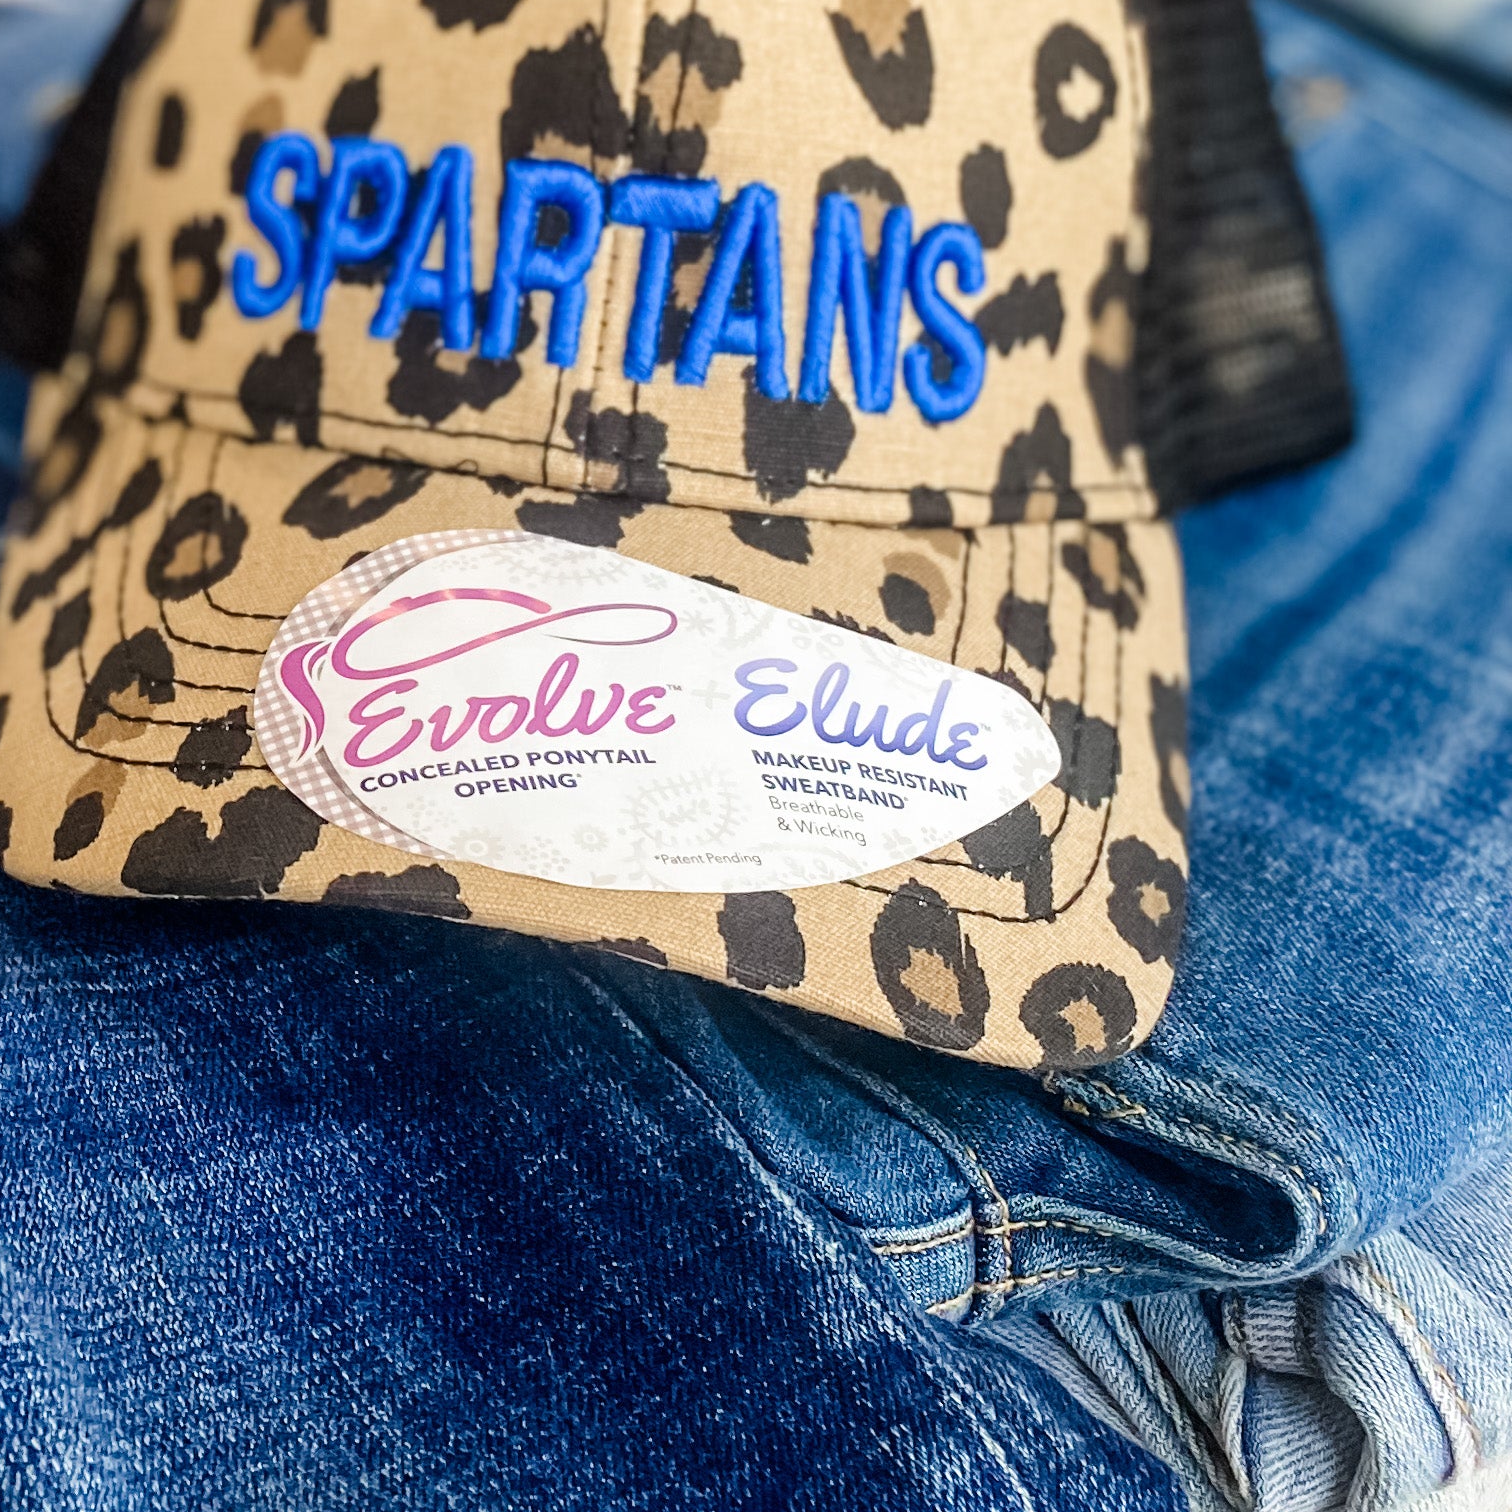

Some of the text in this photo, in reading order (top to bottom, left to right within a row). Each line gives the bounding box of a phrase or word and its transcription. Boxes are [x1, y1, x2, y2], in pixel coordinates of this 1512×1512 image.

[232, 131, 986, 423] SPARTANS
[359, 749, 656, 793] CONCEALED PONYTAIL
[751, 749, 968, 802] MAKEUP RESISTANT
[768, 795, 864, 822] Breathable
[777, 816, 867, 847] & Wicking
[705, 852, 762, 866] Pending
